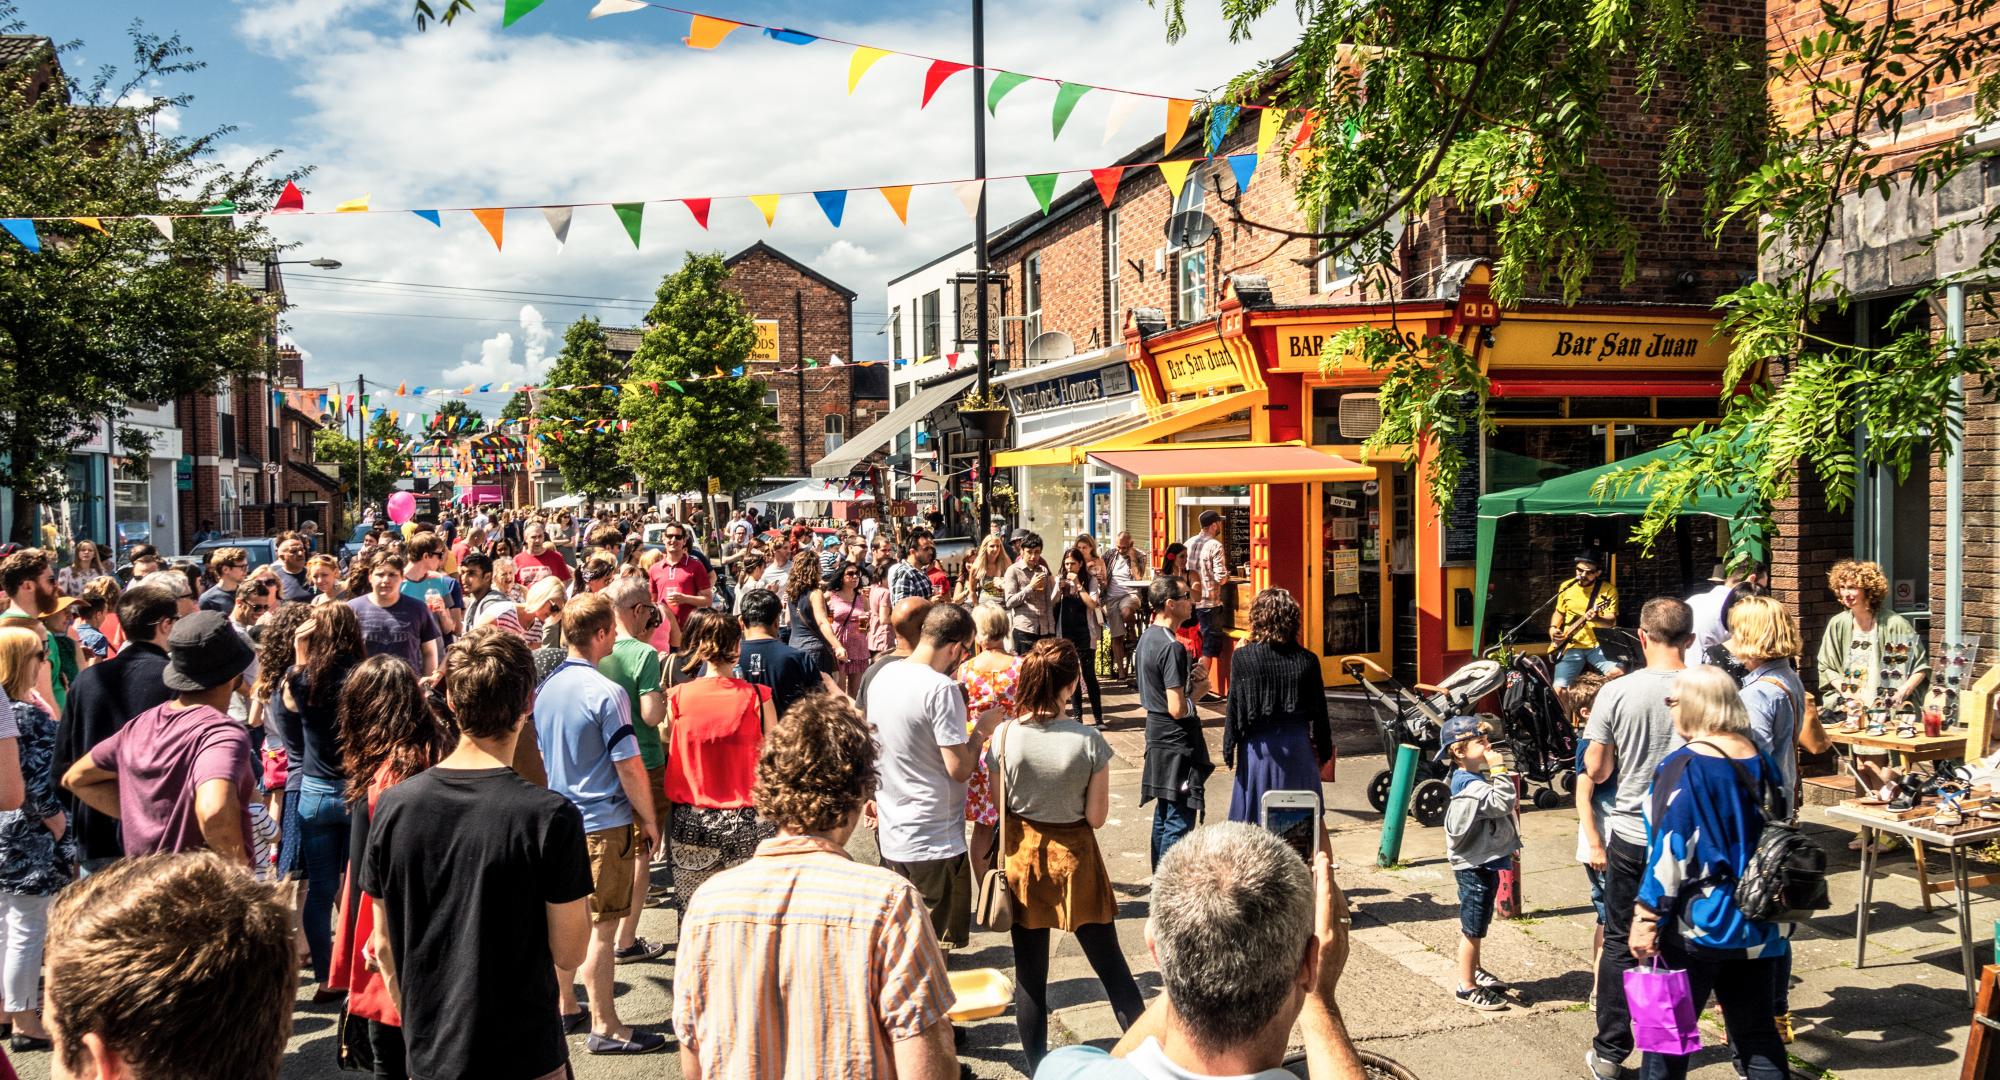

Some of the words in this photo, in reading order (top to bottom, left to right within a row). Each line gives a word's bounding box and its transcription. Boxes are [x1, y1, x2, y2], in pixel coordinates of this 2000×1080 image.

[1289, 335, 1324, 357] BAR
[1552, 331, 1597, 357] Bar
[1597, 332, 1642, 361] San
[1645, 333, 1699, 358] Juan
[1167, 360, 1186, 380] Bar
[1185, 353, 1206, 379] San
[1204, 347, 1234, 371] Juan
[1011, 380, 1060, 414] Sherlock
[1059, 377, 1100, 404] Homes
[1334, 498, 1352, 507] OPEN
